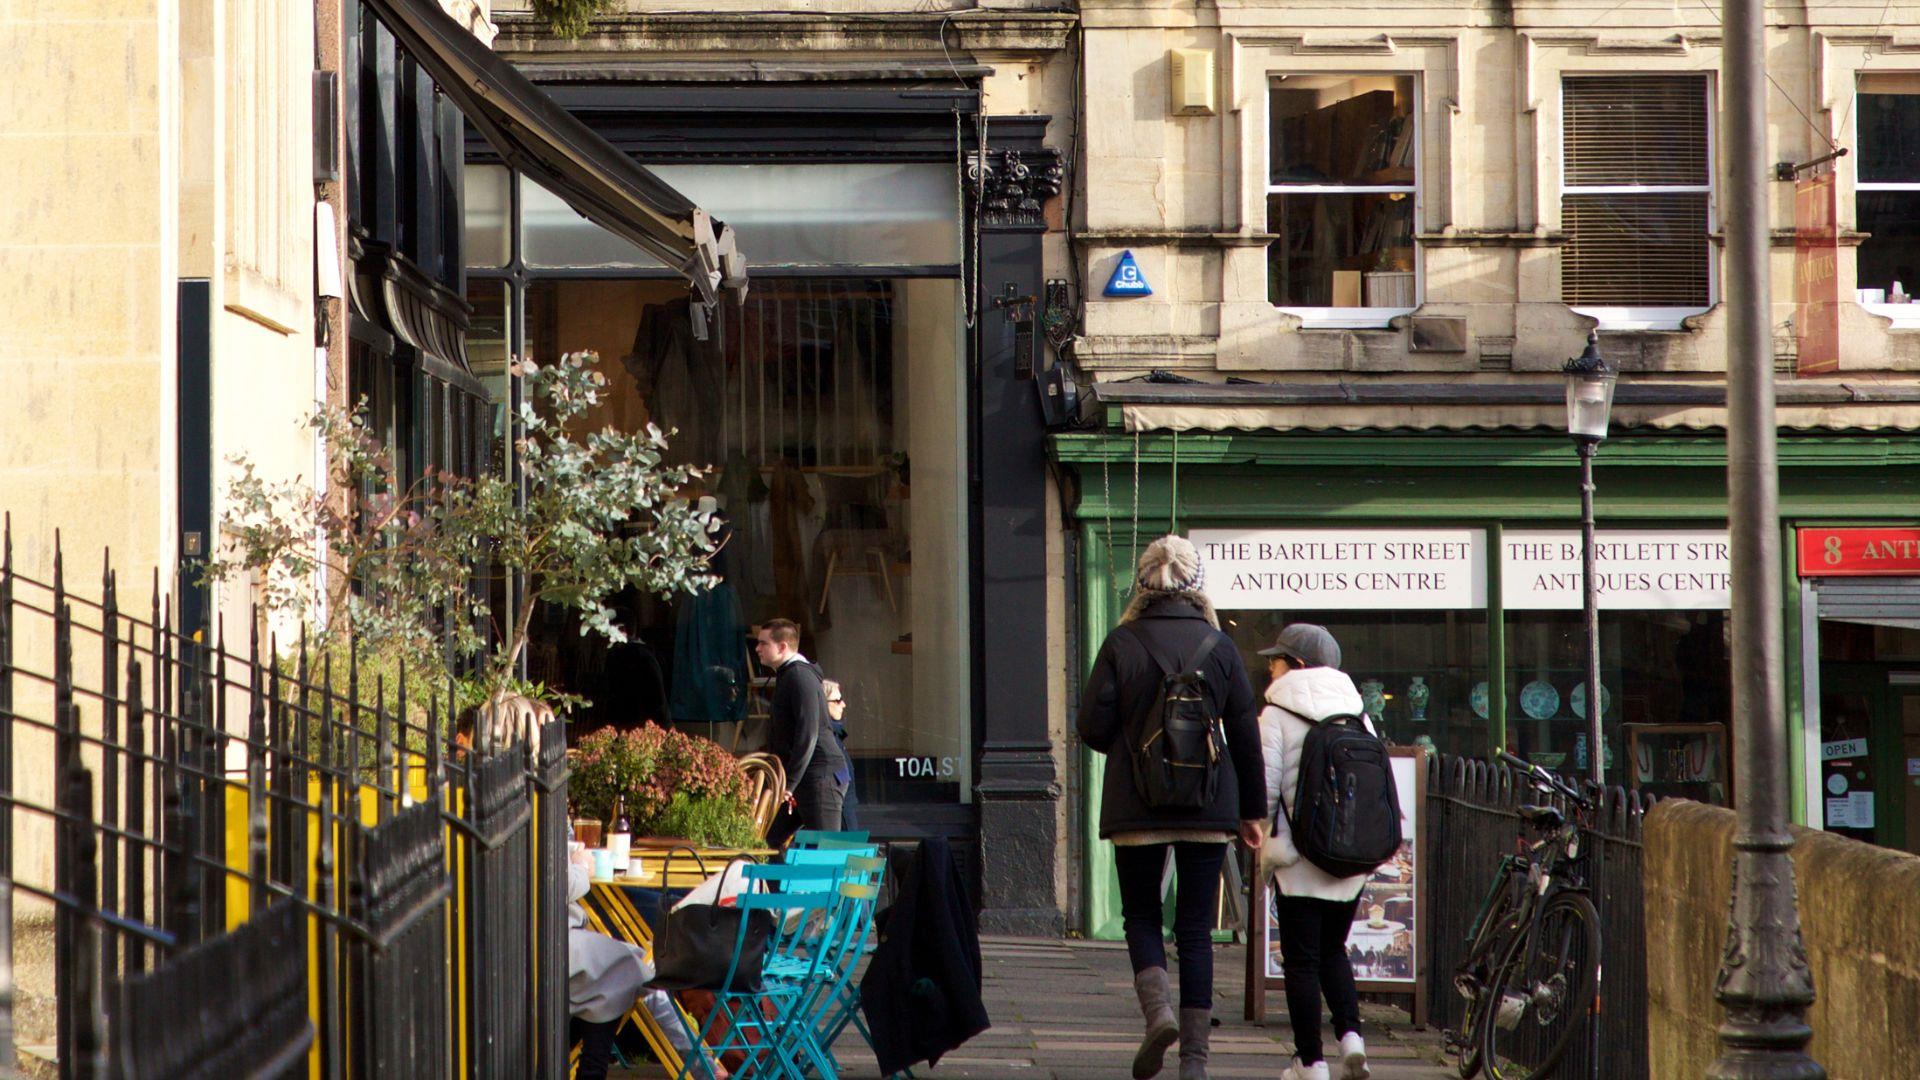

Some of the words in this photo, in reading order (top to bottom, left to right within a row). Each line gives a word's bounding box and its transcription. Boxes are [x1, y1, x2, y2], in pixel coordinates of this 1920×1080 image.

[1205, 542, 1252, 561] THE
[1258, 542, 1377, 561] BARTLETT
[1384, 542, 1470, 561] STREET
[1507, 543, 1553, 561] THE
[1823, 535, 1843, 565] 8
[1230, 572, 1348, 595] ANTIQUES
[1354, 572, 1447, 591] CENTRE
[1533, 572, 1651, 595] ANTQUES
[1657, 572, 1732, 591] CENTR
[1826, 743, 1856, 756] OPEN
